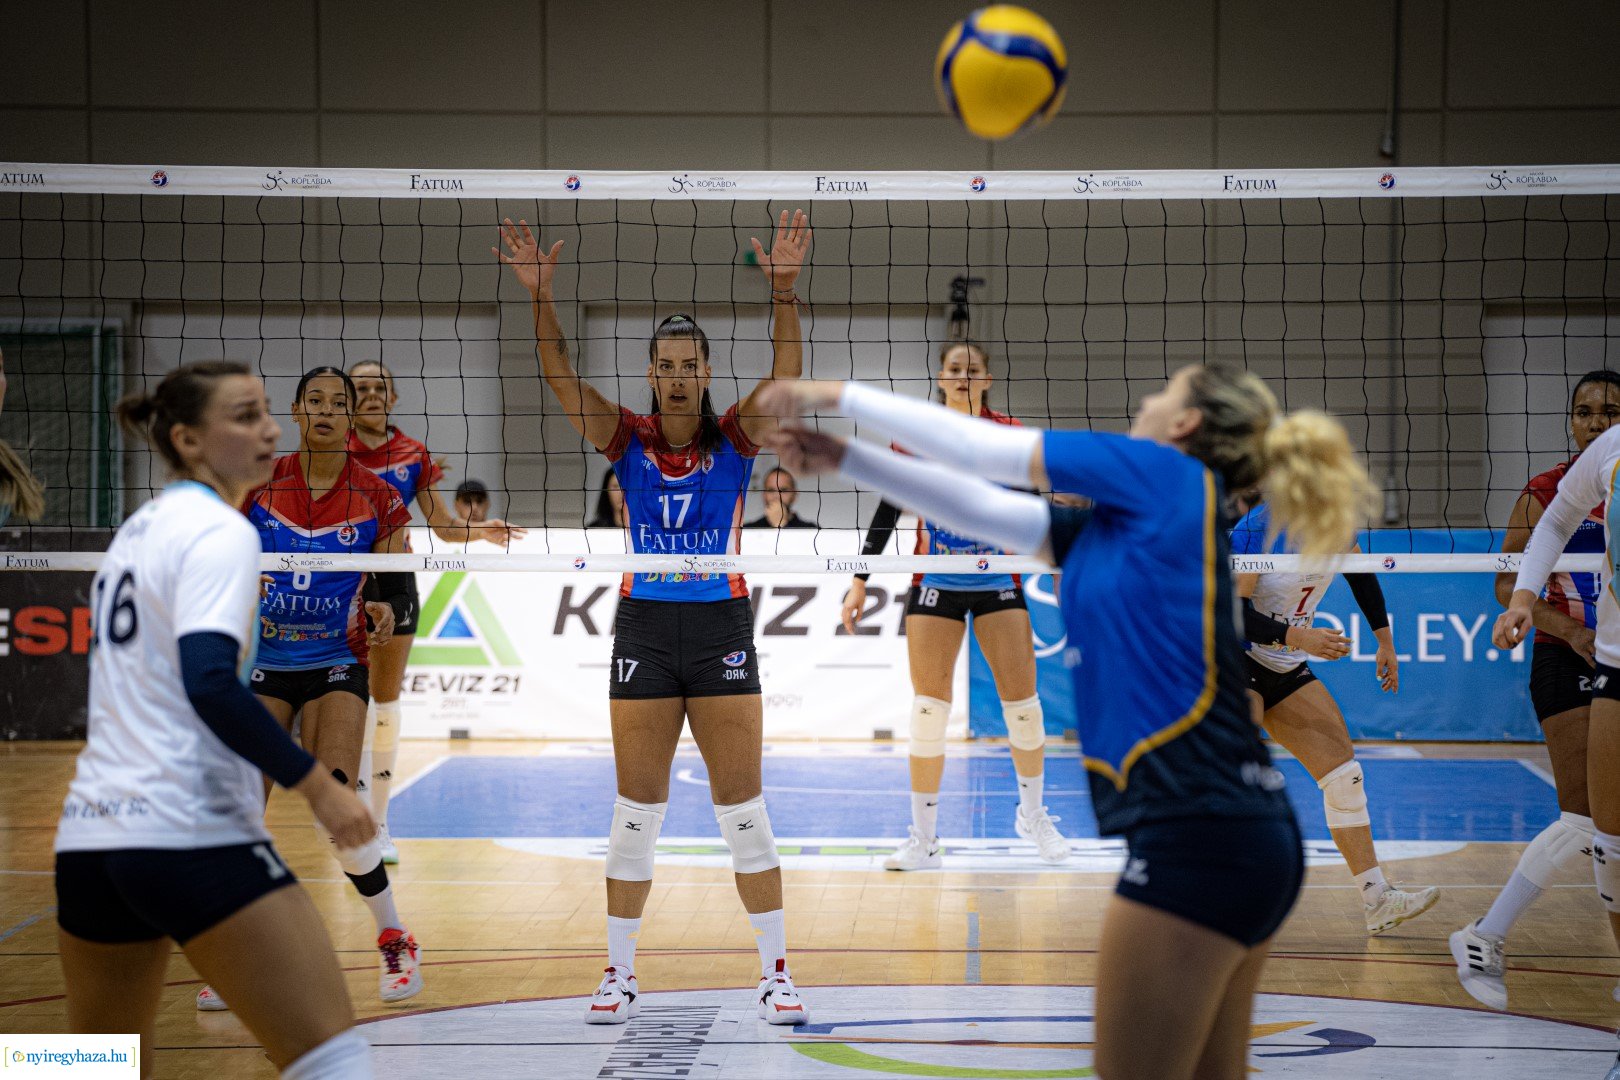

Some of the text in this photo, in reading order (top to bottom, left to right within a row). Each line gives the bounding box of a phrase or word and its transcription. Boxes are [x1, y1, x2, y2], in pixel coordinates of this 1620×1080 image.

[410, 174, 464, 190] FATUM
[814, 176, 868, 192] FATUM
[1223, 174, 1277, 190] FATUM
[658, 493, 693, 529] 17
[638, 523, 719, 550] FATUM
[6, 555, 49, 568] FATUM
[424, 557, 466, 570] FATUM
[826, 558, 869, 571] FATUM
[1231, 558, 1274, 570] FATUM
[261, 581, 341, 612] FATUM
[918, 586, 939, 608] 18
[1294, 586, 1315, 616] 7
[616, 658, 639, 683] 17
[492, 674, 520, 692] 21
